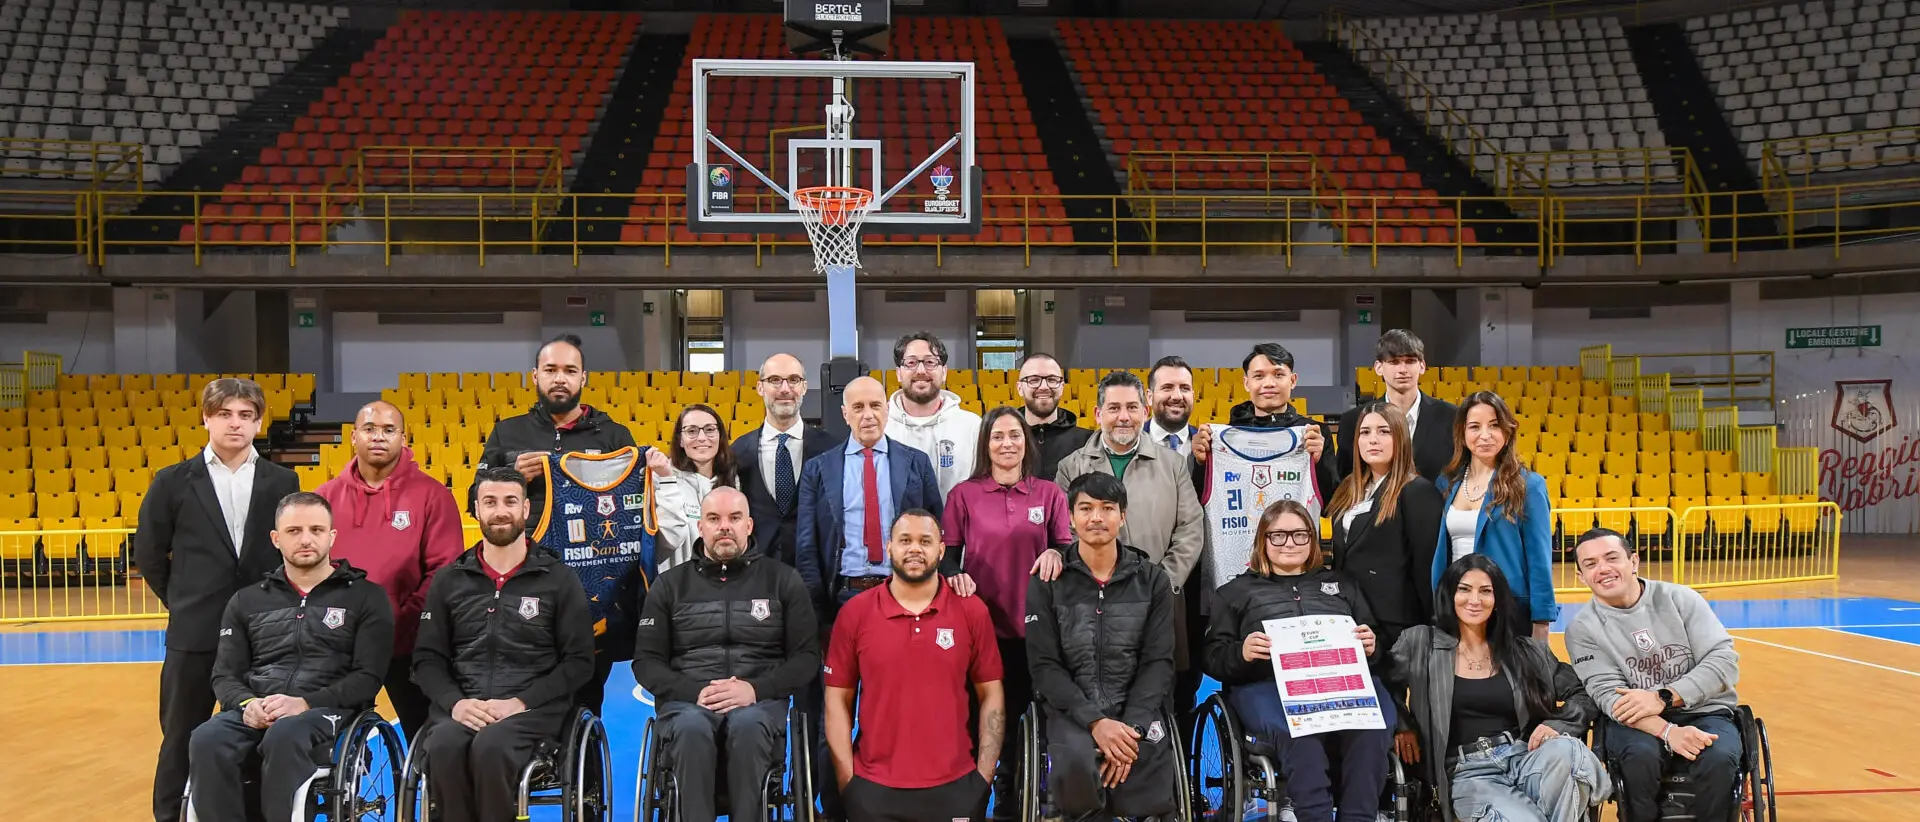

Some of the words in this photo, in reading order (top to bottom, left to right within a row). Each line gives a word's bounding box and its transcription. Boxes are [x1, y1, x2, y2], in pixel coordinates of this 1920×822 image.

[712, 191, 728, 200] FIBA
[1797, 329, 1825, 338] LOCALE
[1808, 337, 1856, 347] EMERGENZE
[1277, 471, 1301, 481] HDI
[1227, 489, 1243, 511] 21
[1222, 516, 1248, 529] FISIO
[567, 519, 586, 543] 10
[1625, 647, 1674, 681] Reggio
